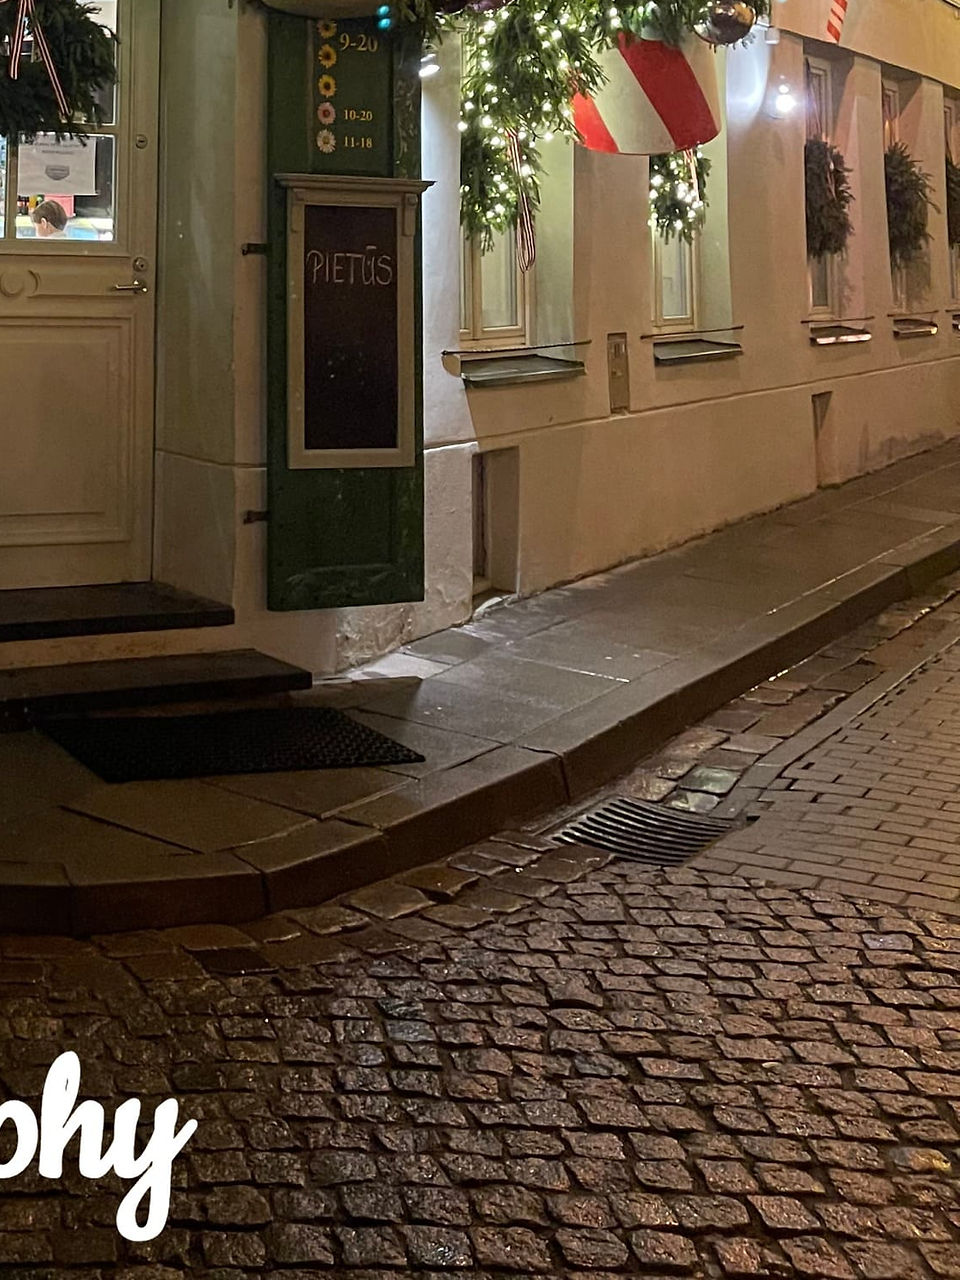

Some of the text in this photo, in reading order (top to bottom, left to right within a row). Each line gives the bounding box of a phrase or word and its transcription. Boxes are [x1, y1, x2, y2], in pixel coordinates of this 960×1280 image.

[340, 32, 378, 53] 9-20
[343, 109, 373, 121] 10-20
[343, 135, 373, 149] 11-18
